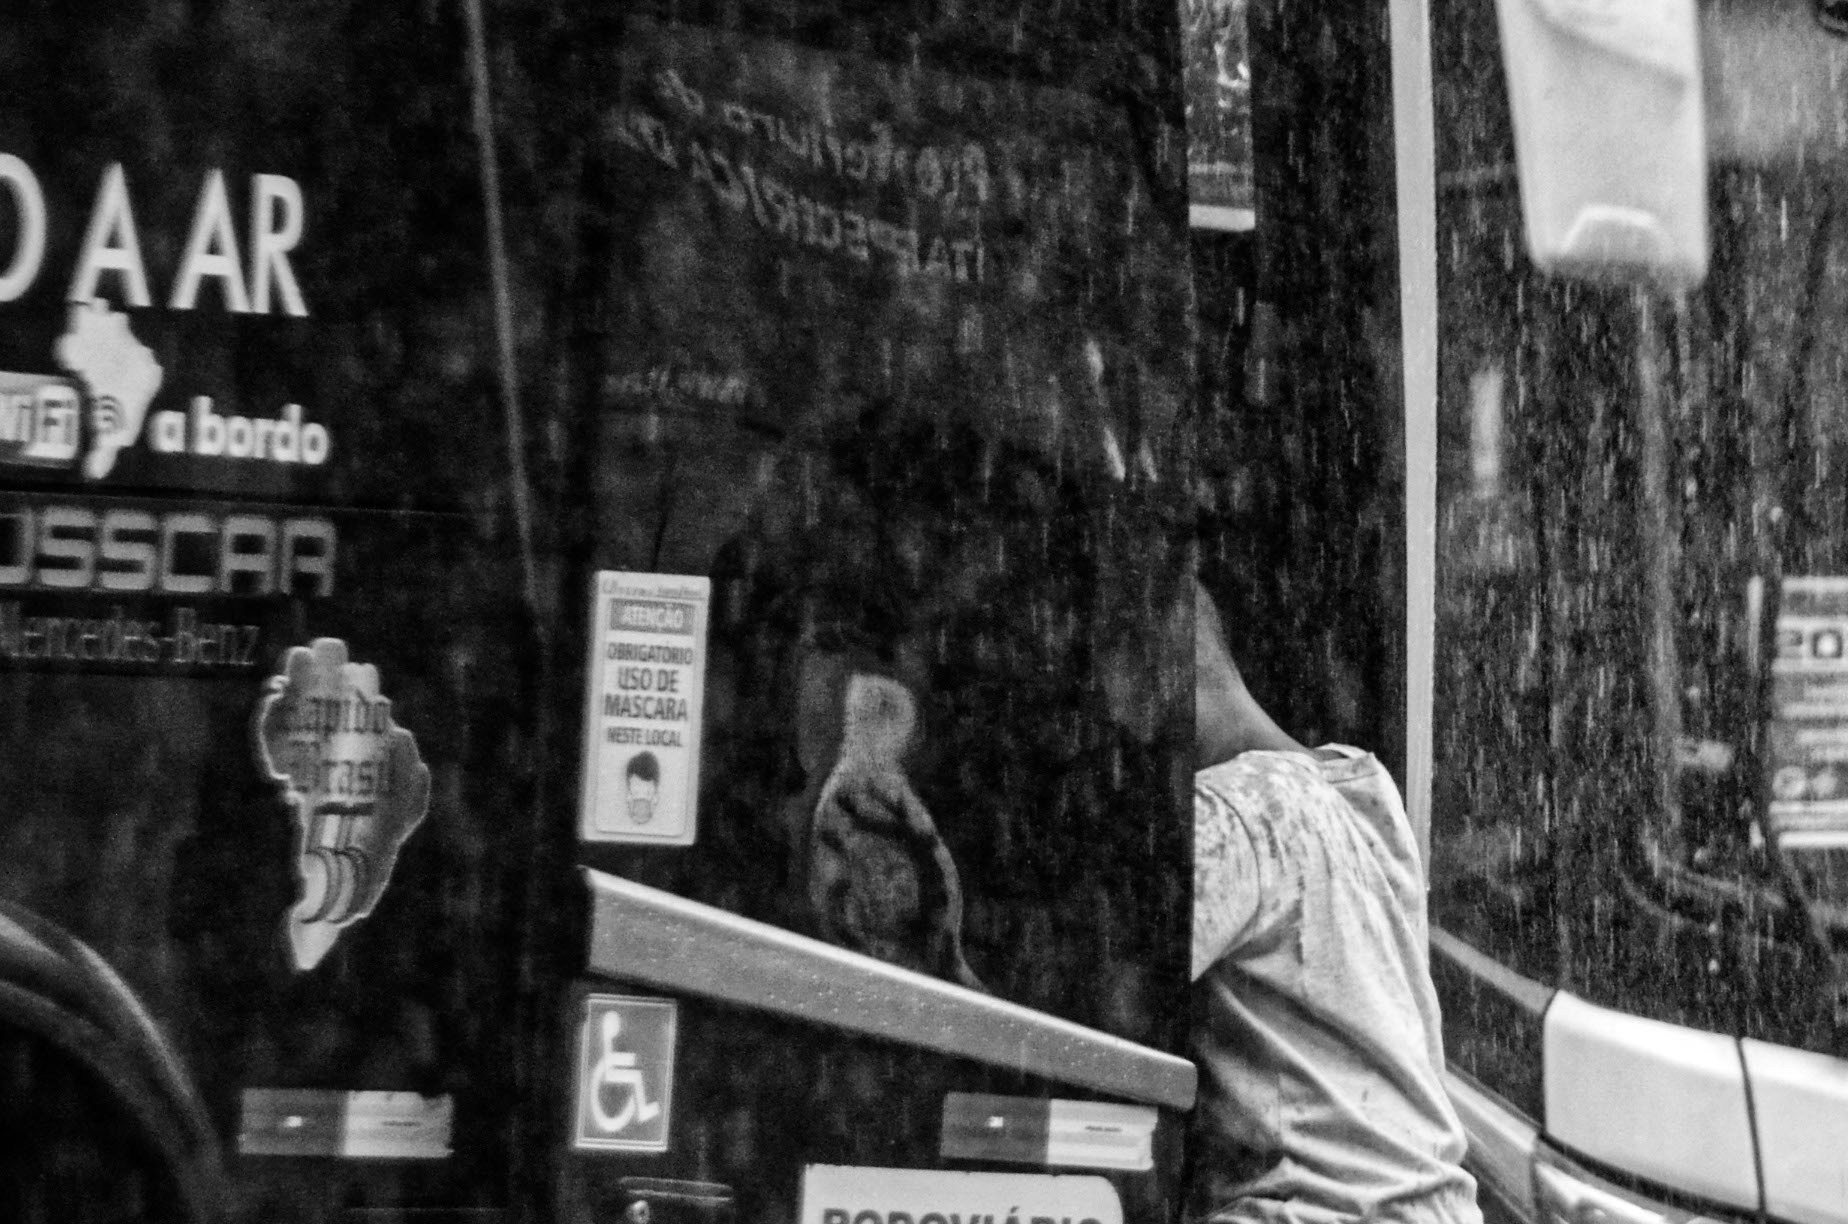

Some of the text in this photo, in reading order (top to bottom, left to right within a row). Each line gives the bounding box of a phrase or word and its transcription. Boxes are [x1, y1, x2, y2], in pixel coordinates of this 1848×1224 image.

[169, 166, 310, 318] AR
[149, 409, 186, 454] a
[189, 394, 330, 466] bordo
[606, 640, 694, 666] OBRIGATÓRIO
[617, 667, 680, 693] USO DE
[606, 726, 684, 748] NESTE LOCAL
